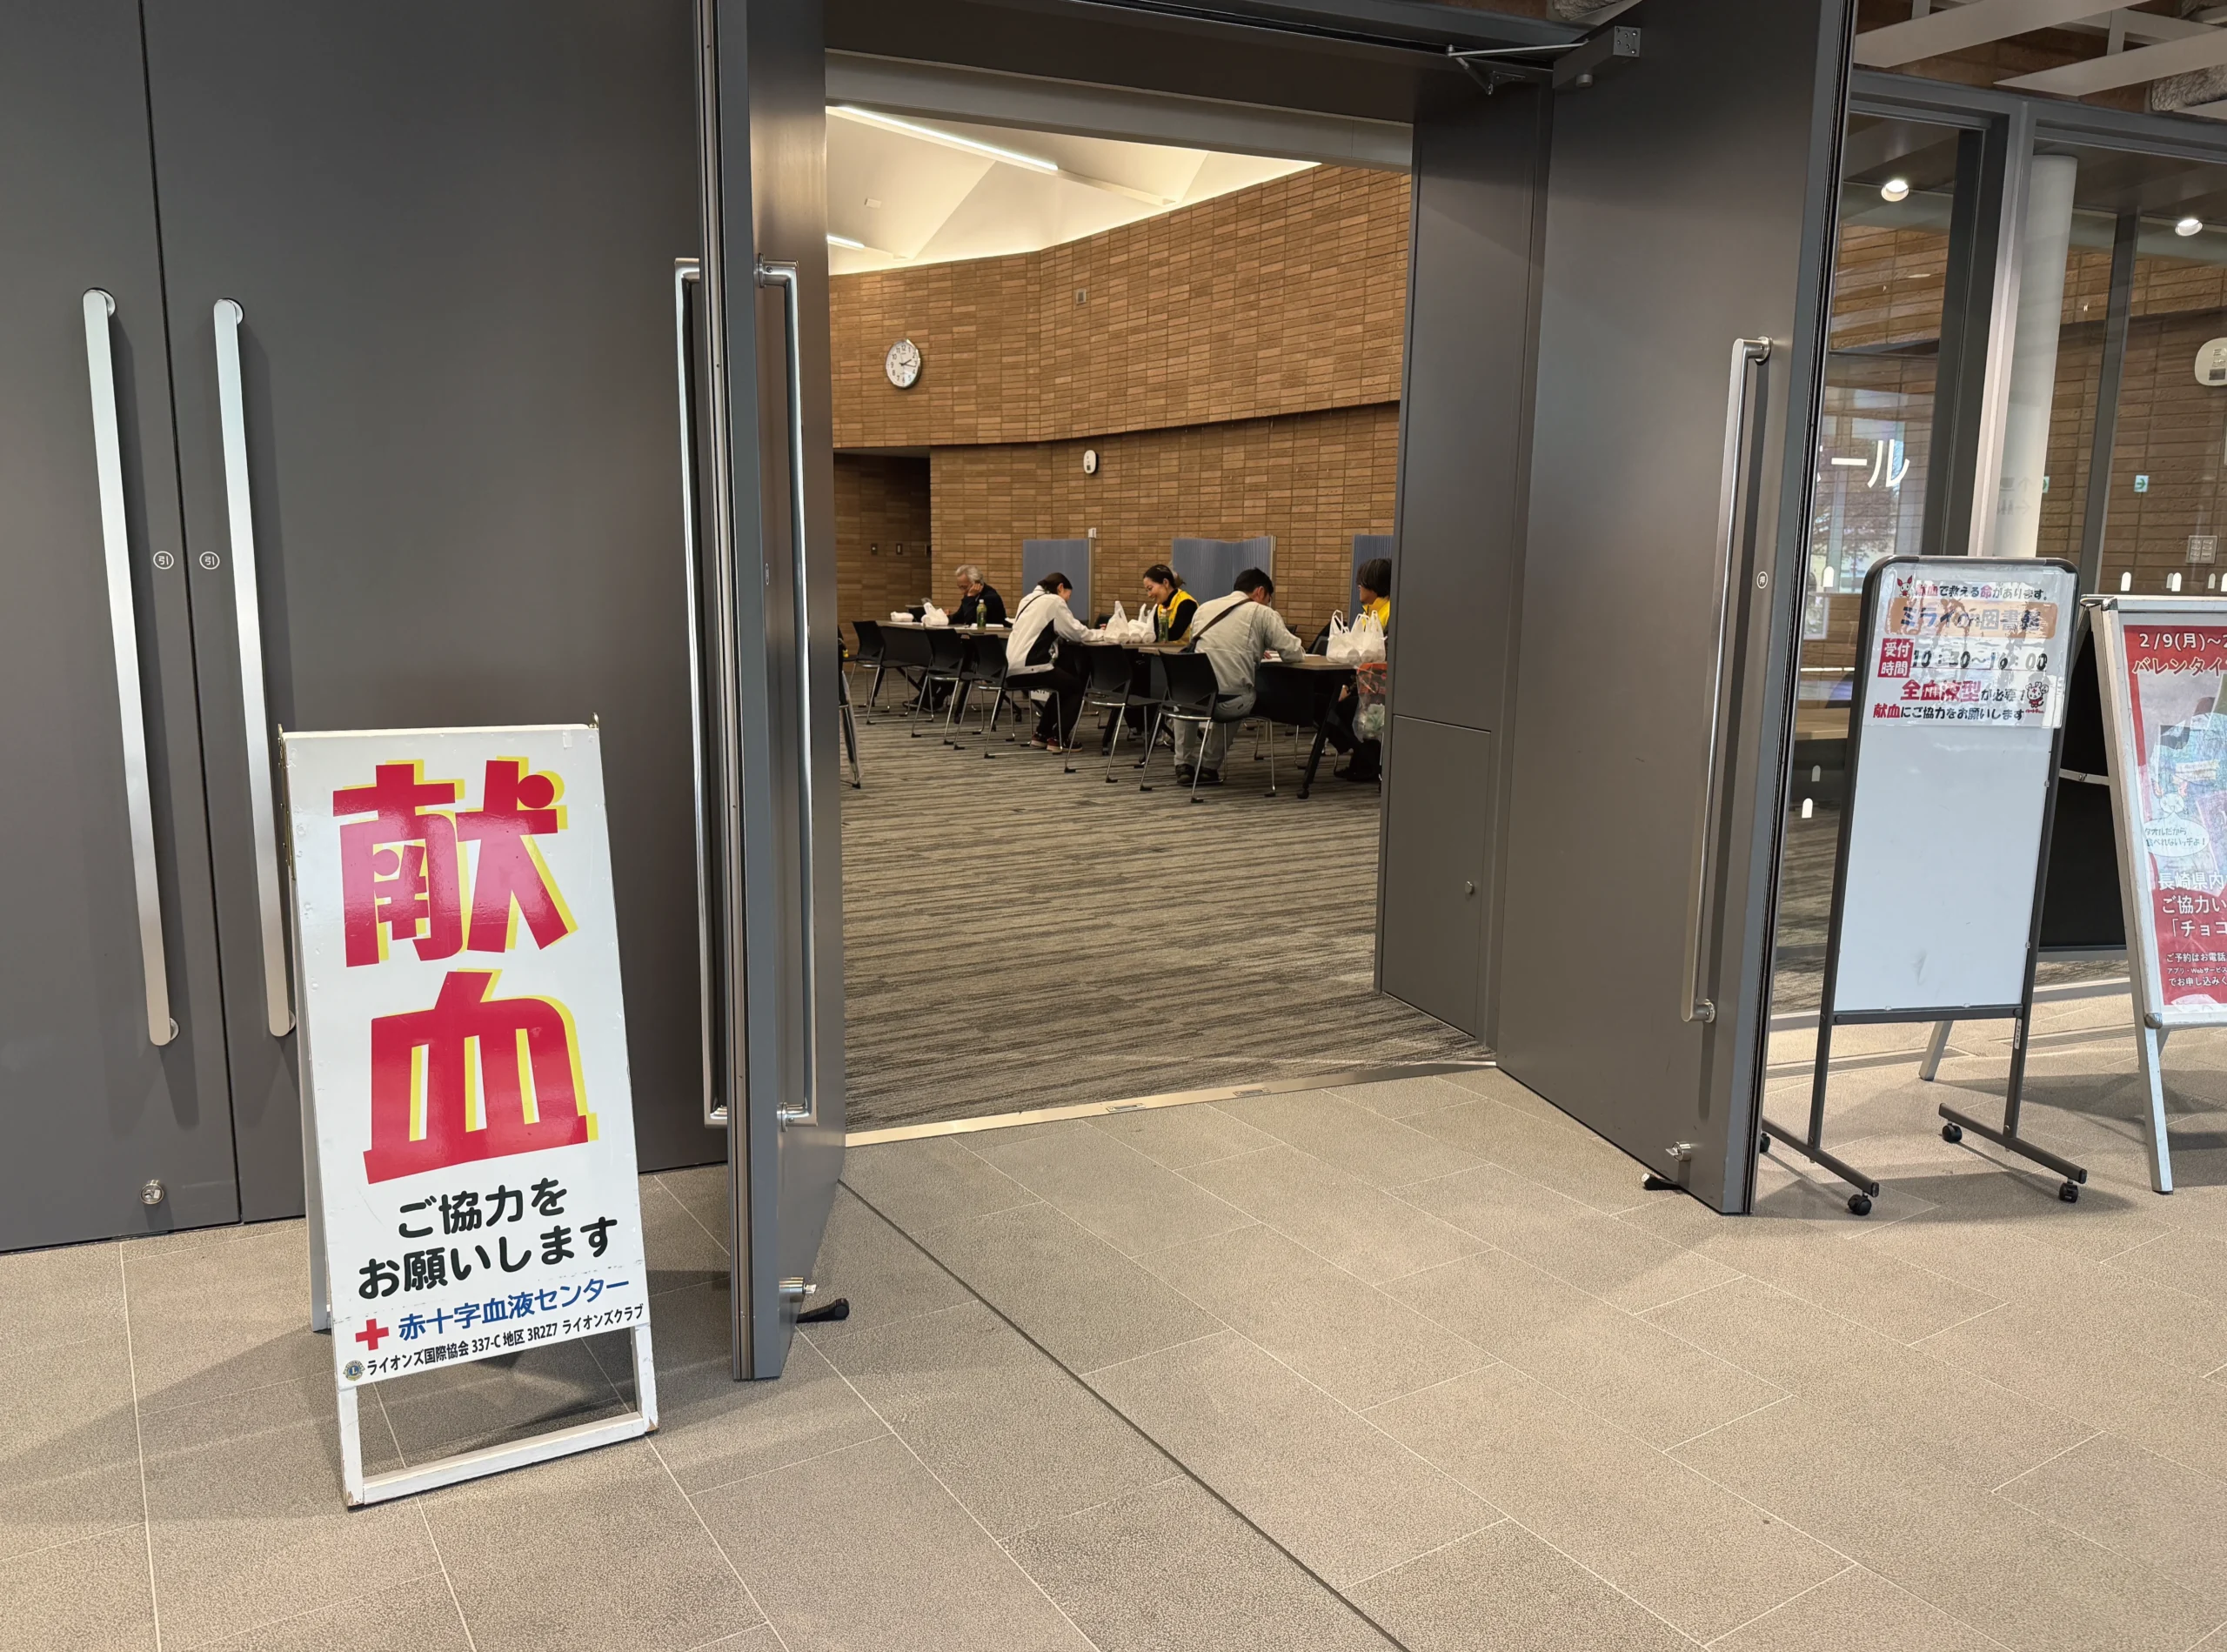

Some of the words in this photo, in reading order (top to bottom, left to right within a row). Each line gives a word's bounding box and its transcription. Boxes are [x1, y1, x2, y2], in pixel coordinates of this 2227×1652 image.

[1817, 439, 1910, 488] ール
[1884, 641, 1911, 658] 受付
[1880, 660, 1909, 676] 時間
[2132, 657, 2227, 678] バレンタイ
[1873, 703, 2024, 721] 献血にご協力をお願いします
[2157, 872, 2227, 891] 長崎県内
[2166, 952, 2226, 963] ご予約はお電話
[332, 755, 599, 1185] 献血
[2168, 976, 2227, 987] でお申し込みく
[398, 1177, 567, 1239] ご協力を
[358, 1216, 618, 1300] お願いします
[398, 1278, 630, 1341] 赤十字血液センター
[366, 1340, 470, 1376] ライオンズ国際協会
[471, 1334, 501, 1354] 337-C
[503, 1328, 525, 1348] 地区
[562, 1302, 645, 1335] ライオンズクラブ
